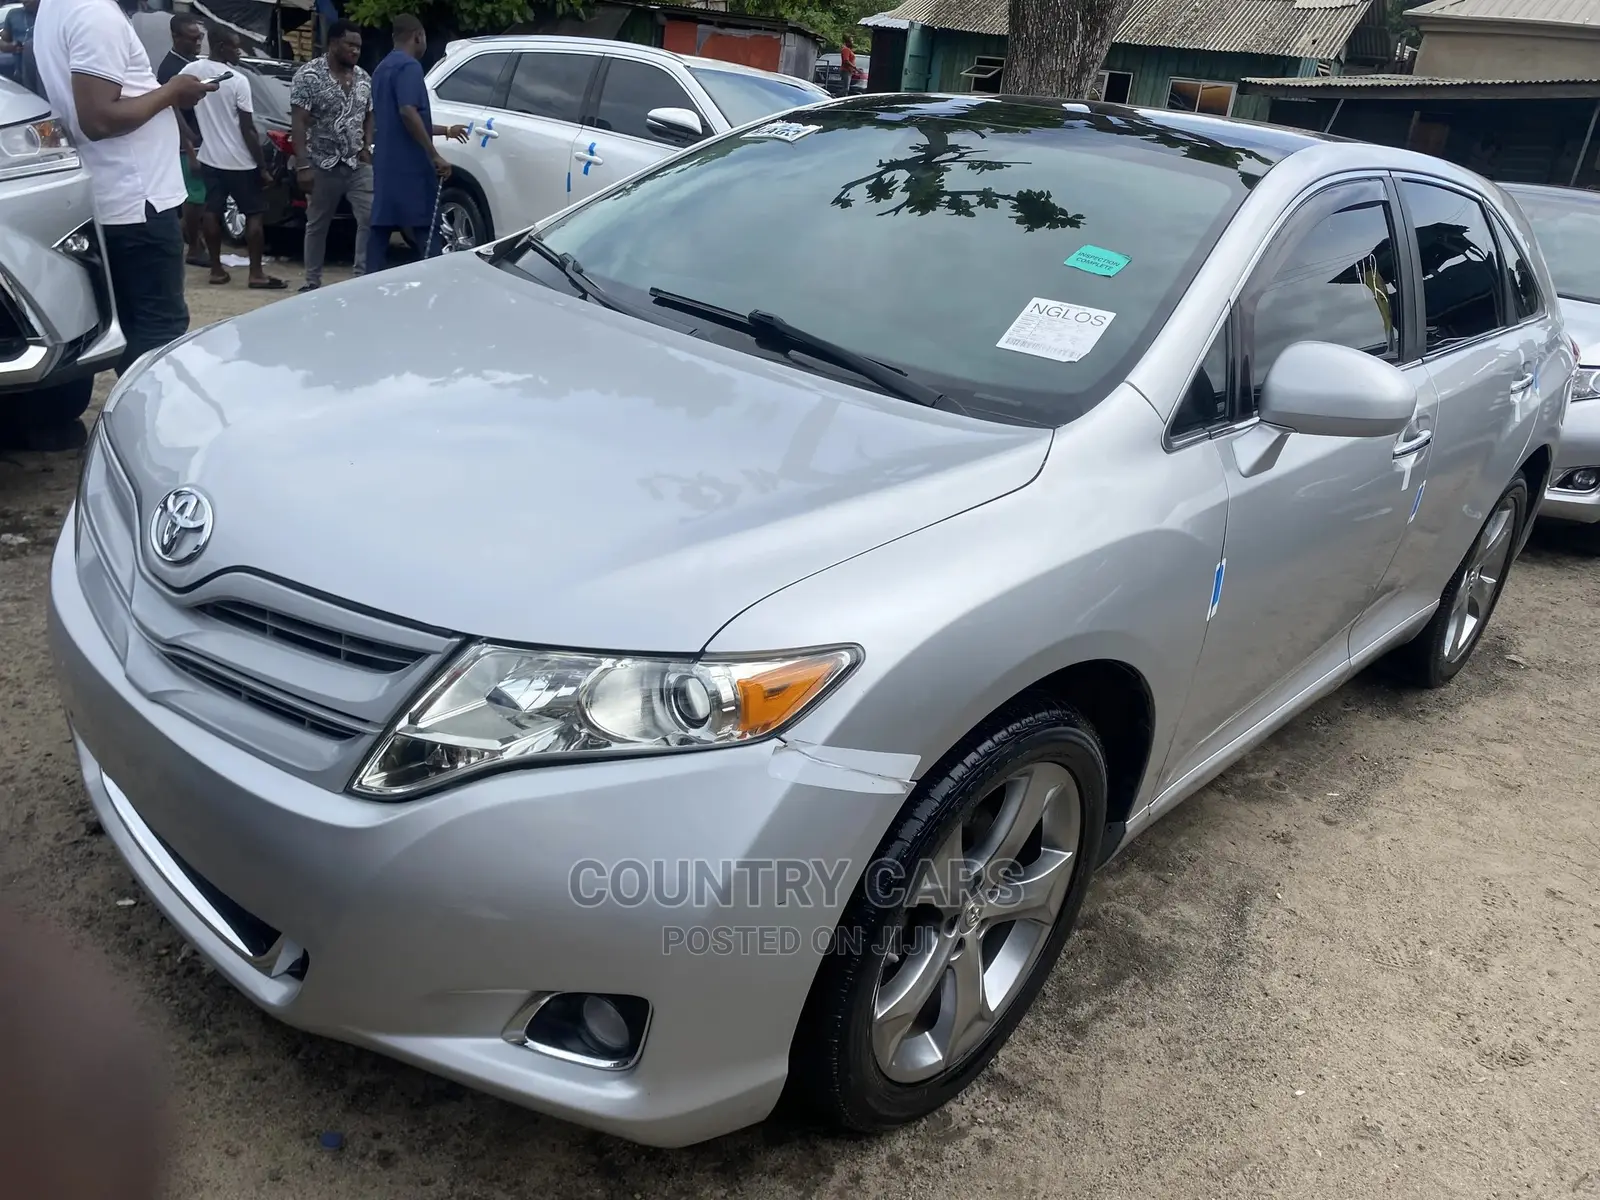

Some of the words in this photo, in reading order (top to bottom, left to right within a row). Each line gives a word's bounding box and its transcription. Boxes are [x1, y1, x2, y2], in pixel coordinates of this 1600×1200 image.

[1076, 257, 1114, 271] COMPLETE
[1078, 252, 1120, 267] INSPECTION
[1030, 303, 1107, 327] NGLOS
